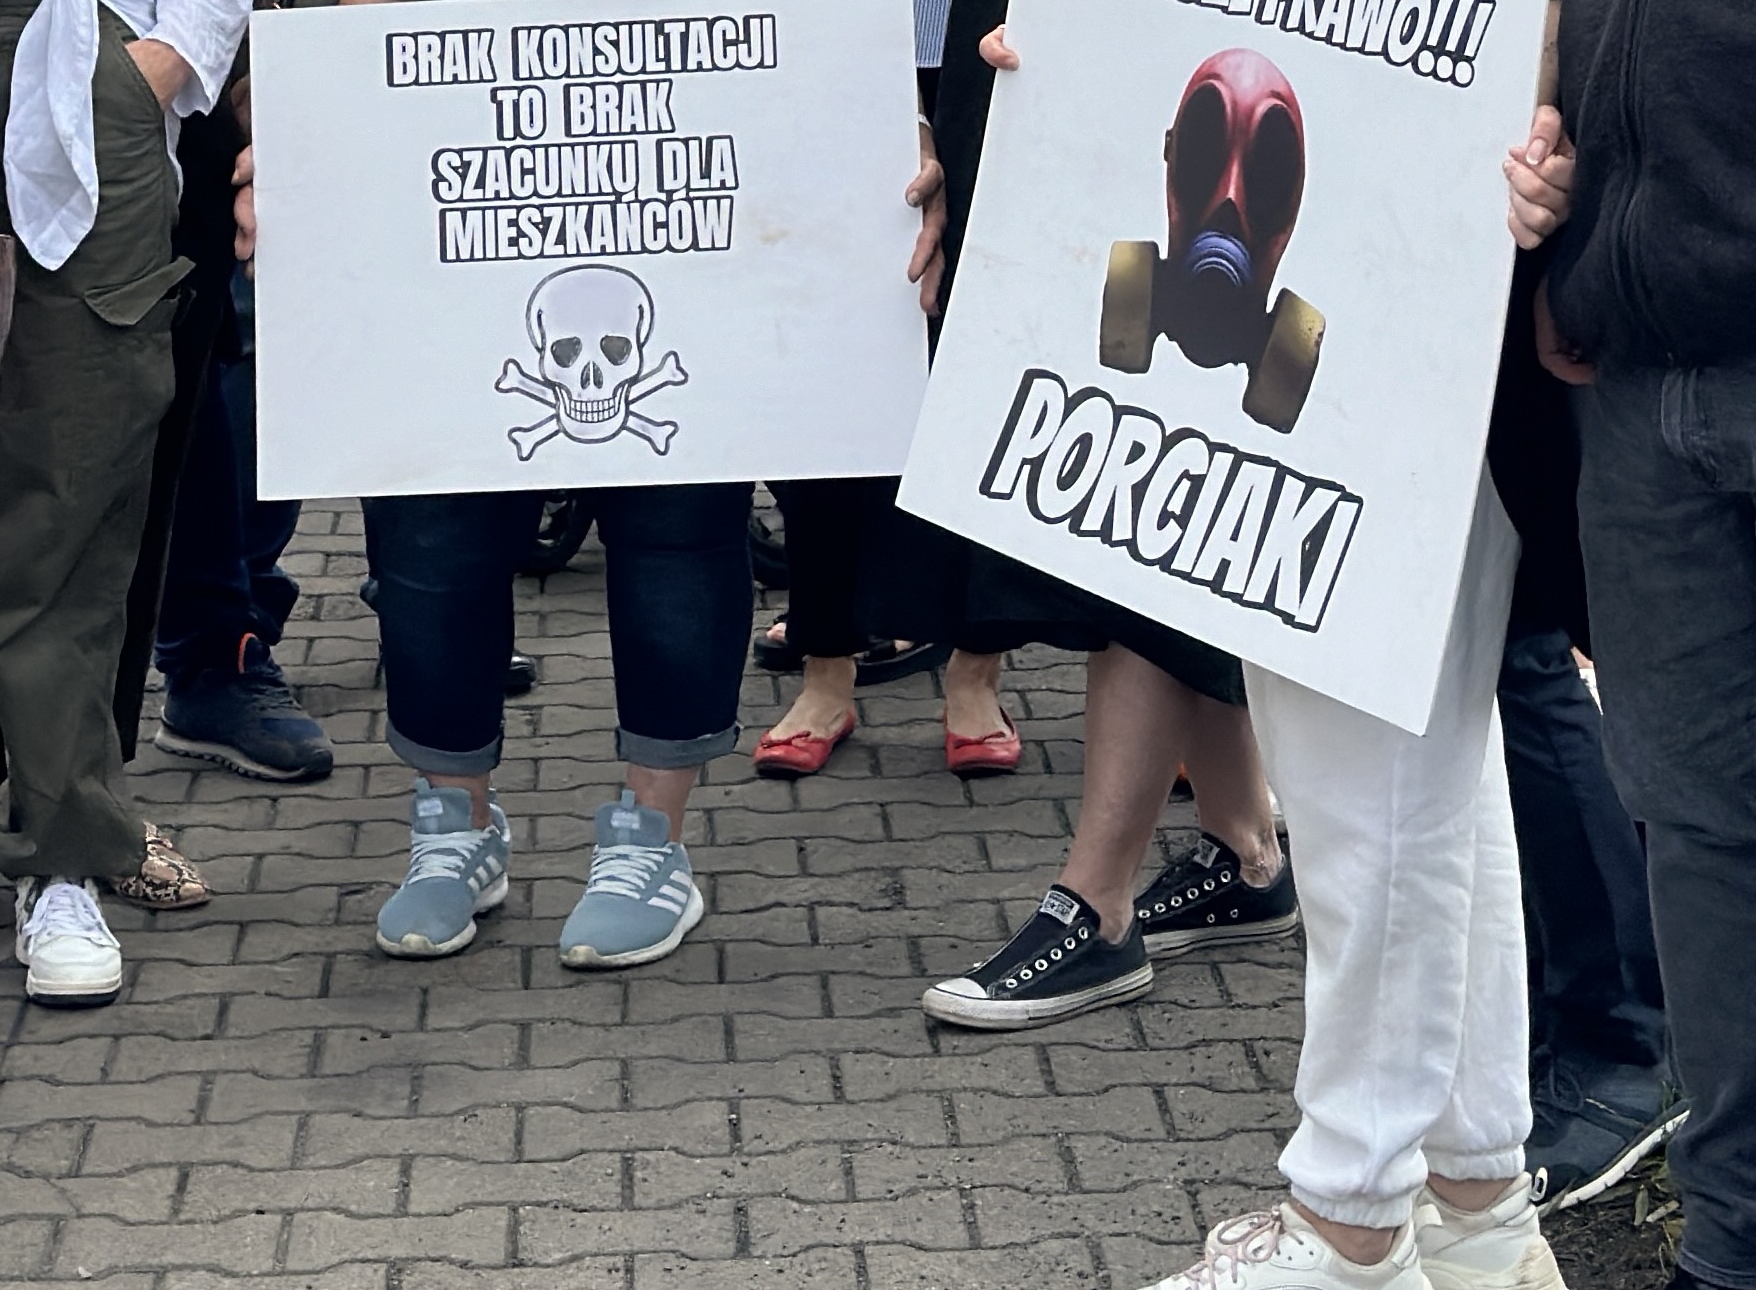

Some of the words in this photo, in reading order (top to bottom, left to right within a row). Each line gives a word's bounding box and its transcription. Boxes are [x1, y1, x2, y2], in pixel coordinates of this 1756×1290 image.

[386, 28, 497, 87] BRAK
[512, 14, 777, 82] KONSULTACJI
[490, 85, 546, 141] TO
[563, 79, 675, 137] BRAK
[432, 140, 639, 203] SZACUNKU
[656, 135, 738, 192] DLA
[439, 189, 734, 263] MIESZKAŃCÓW
[978, 368, 1364, 633] PORCIAKI
